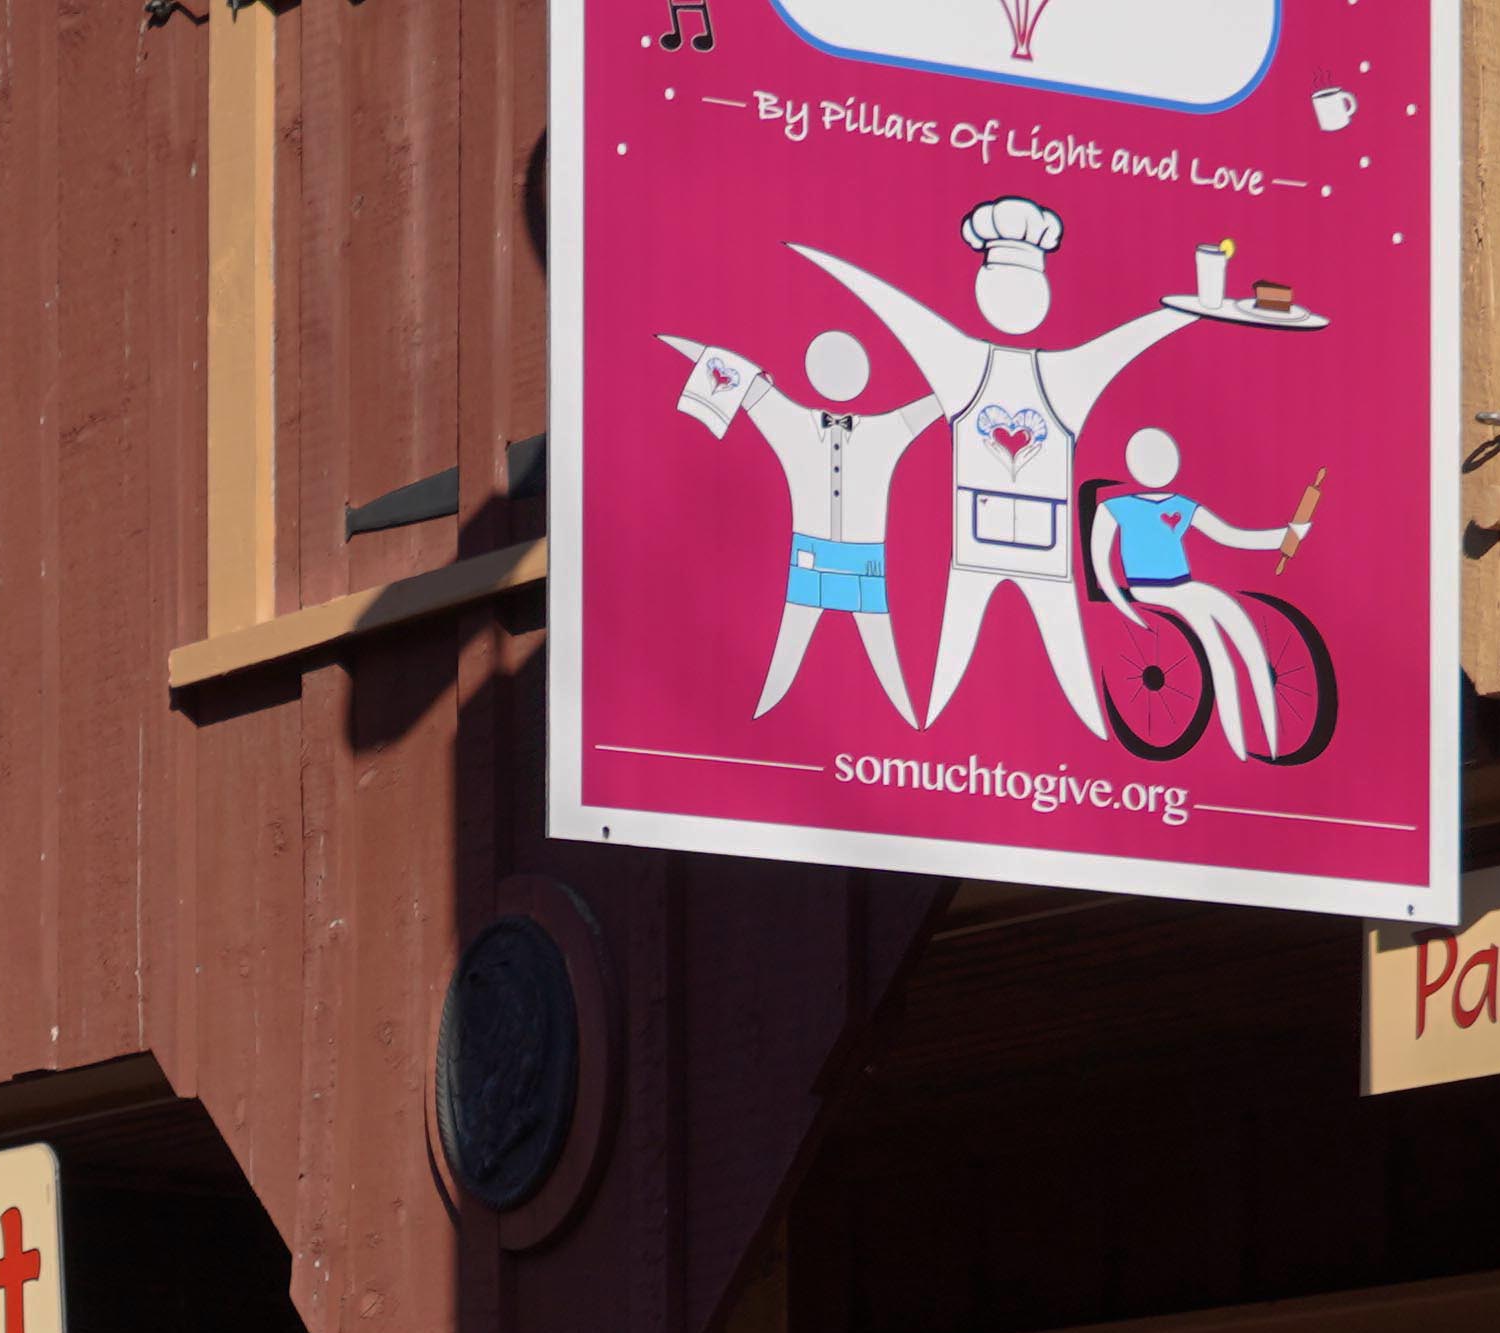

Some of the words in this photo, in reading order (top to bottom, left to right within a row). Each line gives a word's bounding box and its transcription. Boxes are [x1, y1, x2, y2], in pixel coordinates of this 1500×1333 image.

[754, 90, 809, 141] By
[820, 97, 939, 144] Pillars
[950, 120, 999, 164] Of
[1007, 126, 1102, 174] Light
[1111, 150, 1178, 181] and
[1191, 158, 1264, 195] Love
[834, 753, 1188, 825] somuchtogive.org
